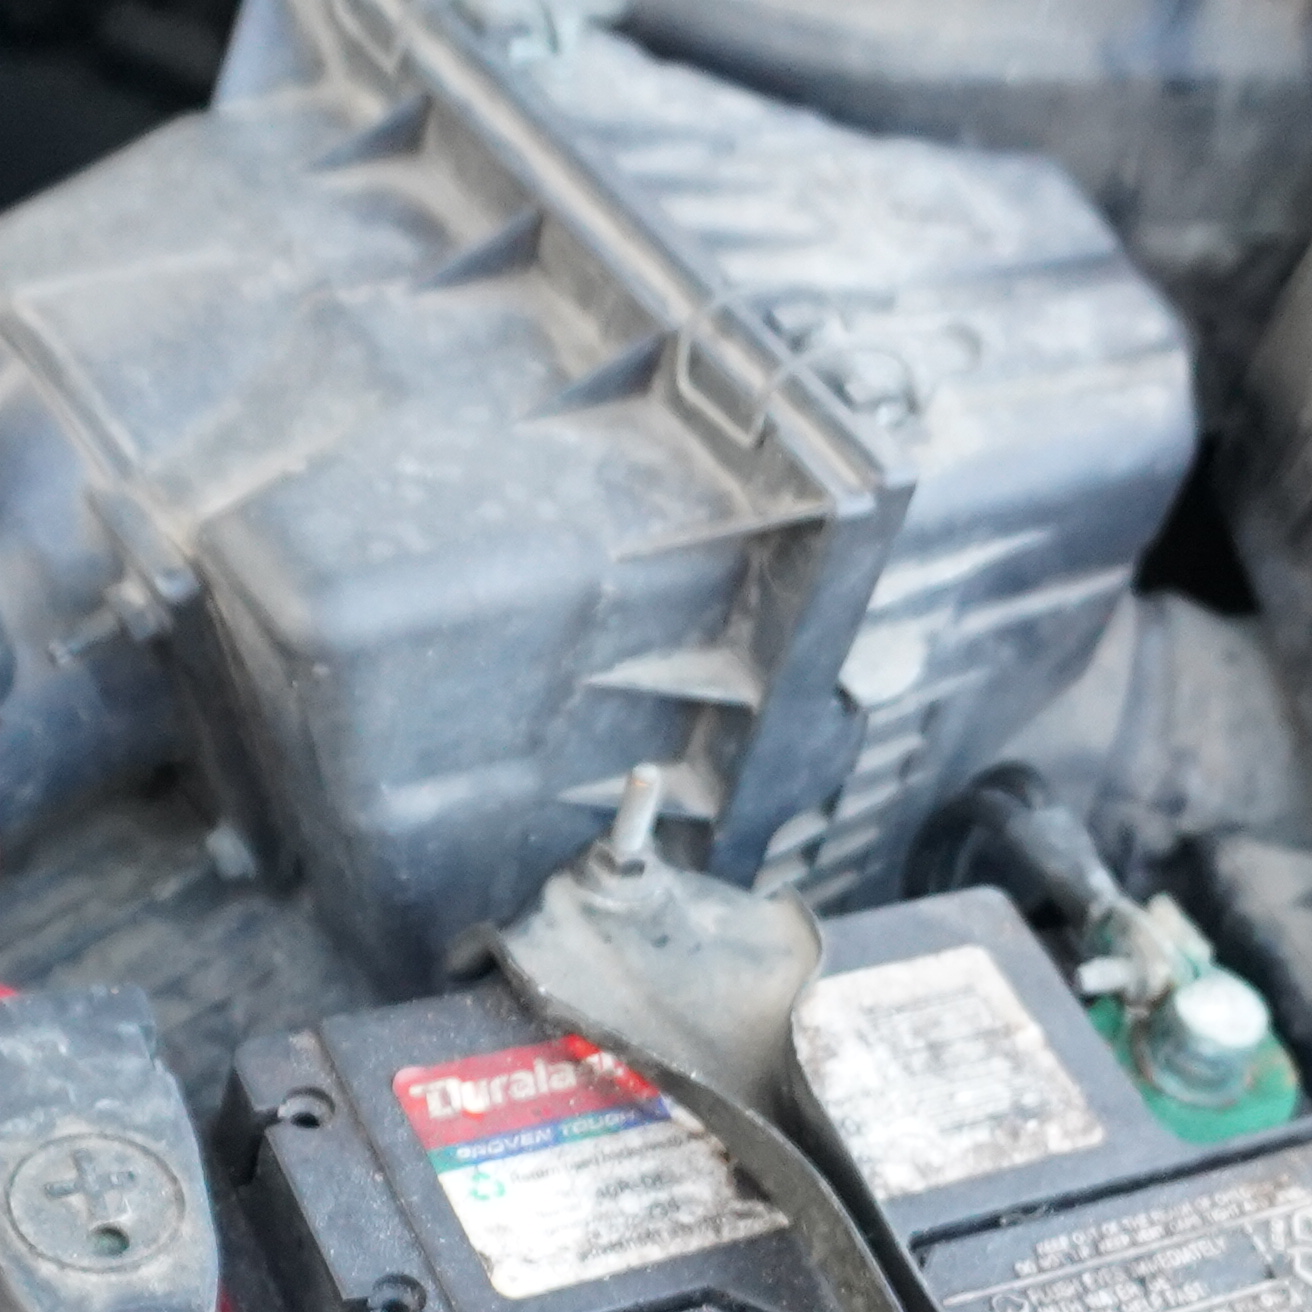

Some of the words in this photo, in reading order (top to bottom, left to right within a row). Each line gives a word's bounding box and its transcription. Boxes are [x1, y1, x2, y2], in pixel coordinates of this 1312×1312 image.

[408, 1053, 625, 1120] Durala
[456, 1127, 553, 1161] PROVEN
[560, 1109, 636, 1138] TOUGH
